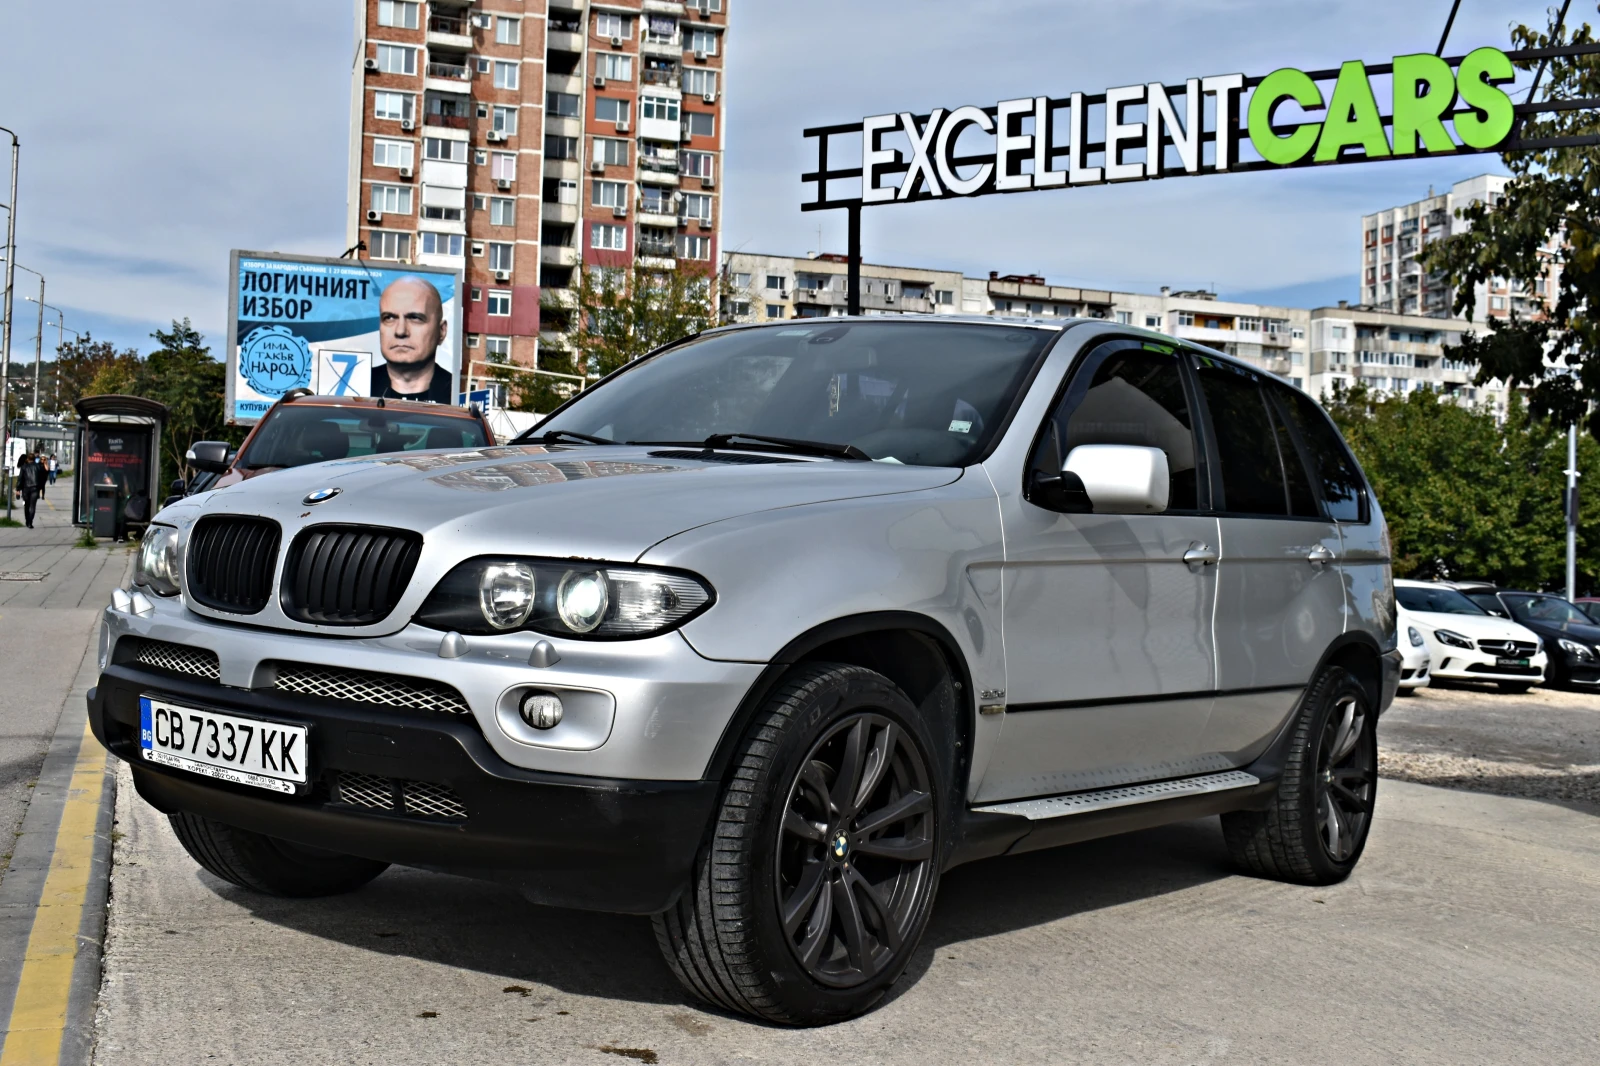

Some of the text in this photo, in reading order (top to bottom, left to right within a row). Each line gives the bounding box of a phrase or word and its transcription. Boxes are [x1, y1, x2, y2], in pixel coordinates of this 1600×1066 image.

[862, 46, 1515, 202] EXCELLENT CARS
[243, 261, 264, 269] ИЗБОРИ
[272, 263, 299, 271] НАРОДНО
[299, 265, 327, 274] СЪБРАНИЕ
[340, 268, 369, 276] ОКТОМВРИ
[242, 271, 371, 300] ЛОГИЧНИЯТ
[243, 295, 312, 320] ИЗБОР
[263, 342, 291, 351] ИМА
[255, 351, 295, 361] ТАКЪВ
[251, 361, 300, 381] НАРОД
[331, 353, 358, 396] 7
[240, 403, 271, 412] КУПУВА
[142, 729, 152, 741] BG
